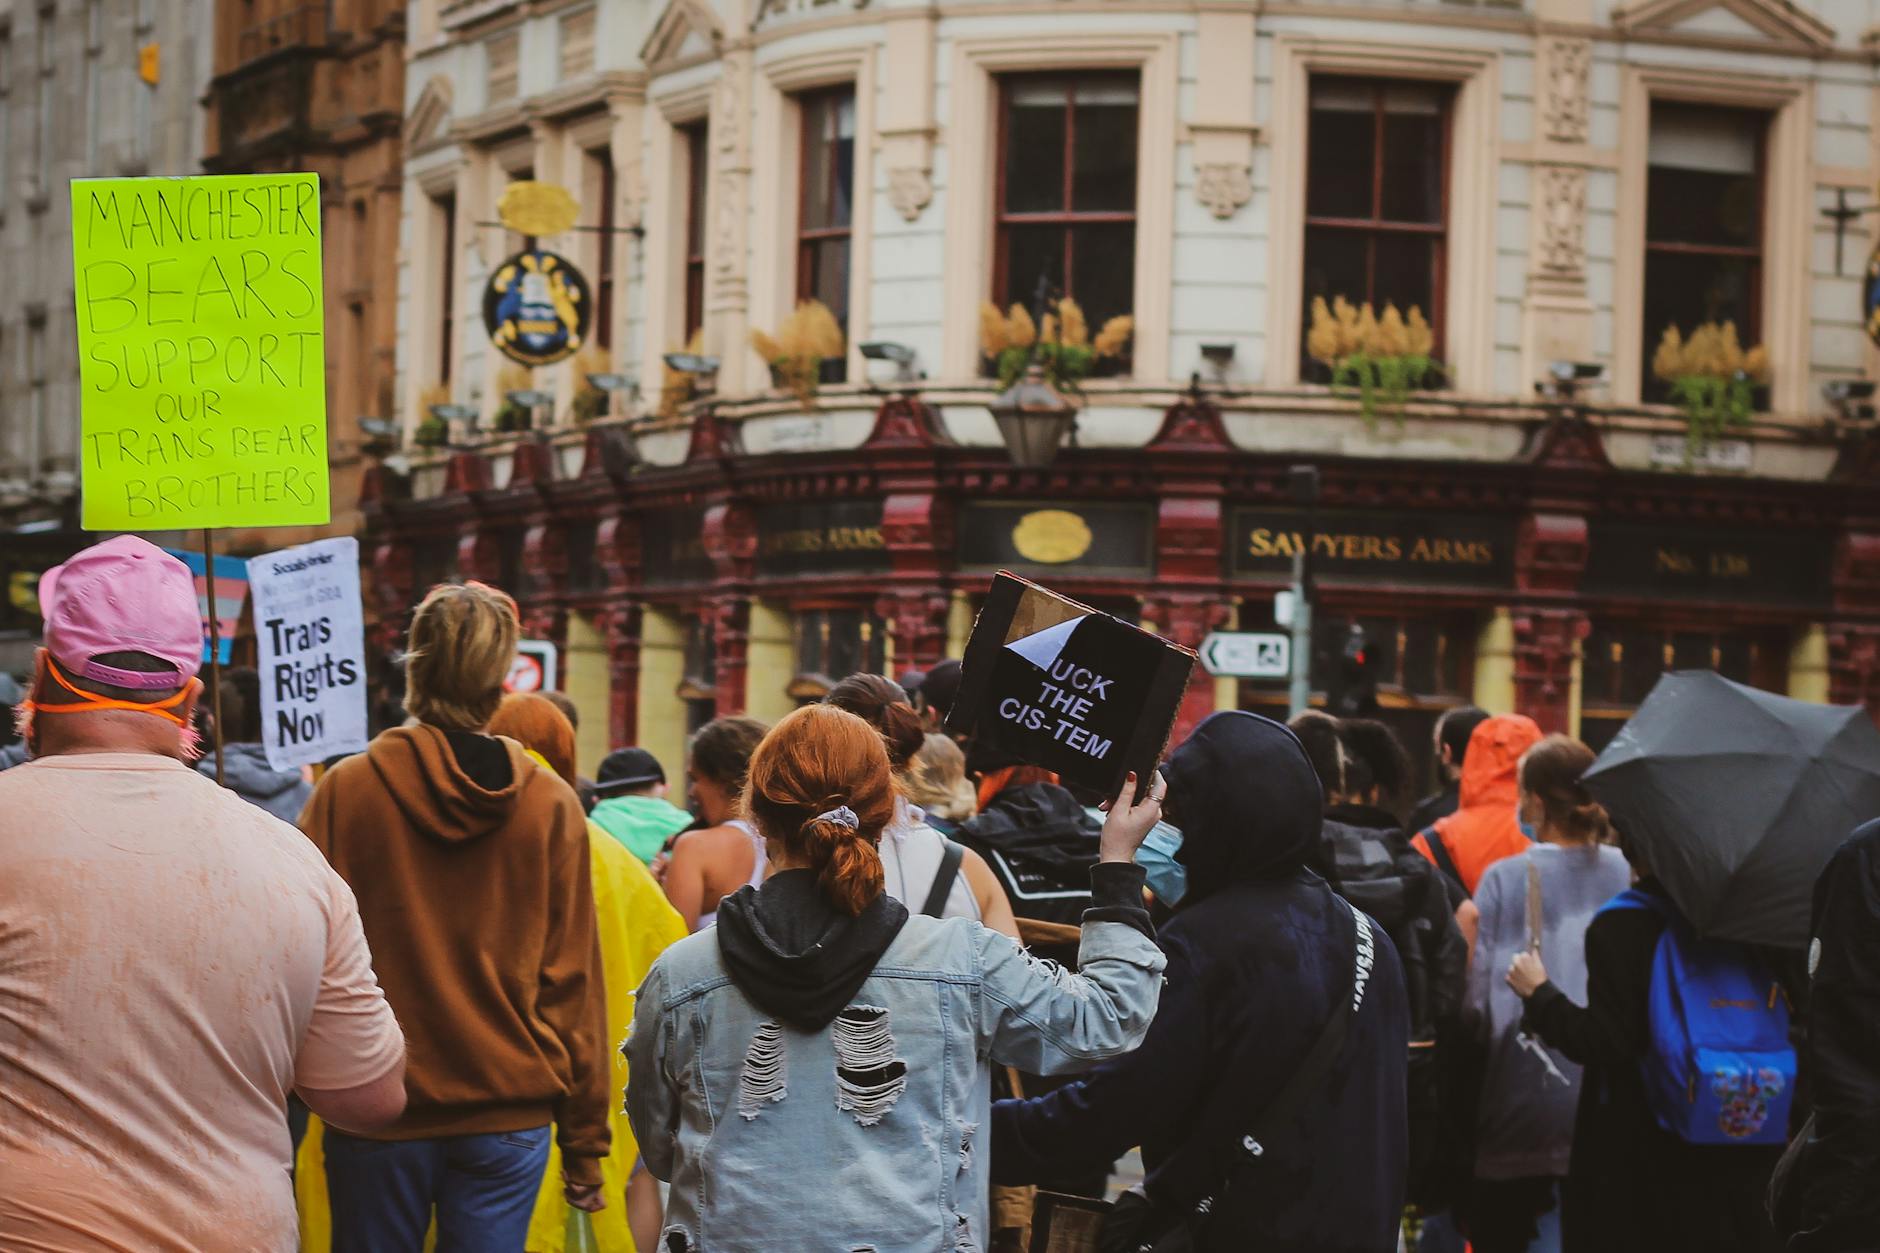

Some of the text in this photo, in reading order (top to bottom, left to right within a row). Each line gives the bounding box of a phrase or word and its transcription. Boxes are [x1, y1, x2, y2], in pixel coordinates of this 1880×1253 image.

[88, 182, 315, 249] MANCHESTER
[84, 250, 315, 333] BEARS
[89, 332, 321, 392] SUPPORT
[155, 390, 221, 423] OUR
[87, 424, 317, 469] TRANS BEAR
[125, 467, 316, 517] BROTHERS
[1410, 537, 1493, 563] ARMS
[1038, 681, 1093, 722] THE
[1050, 658, 1114, 701] UCK
[1000, 697, 1113, 760] CIS-TEM
